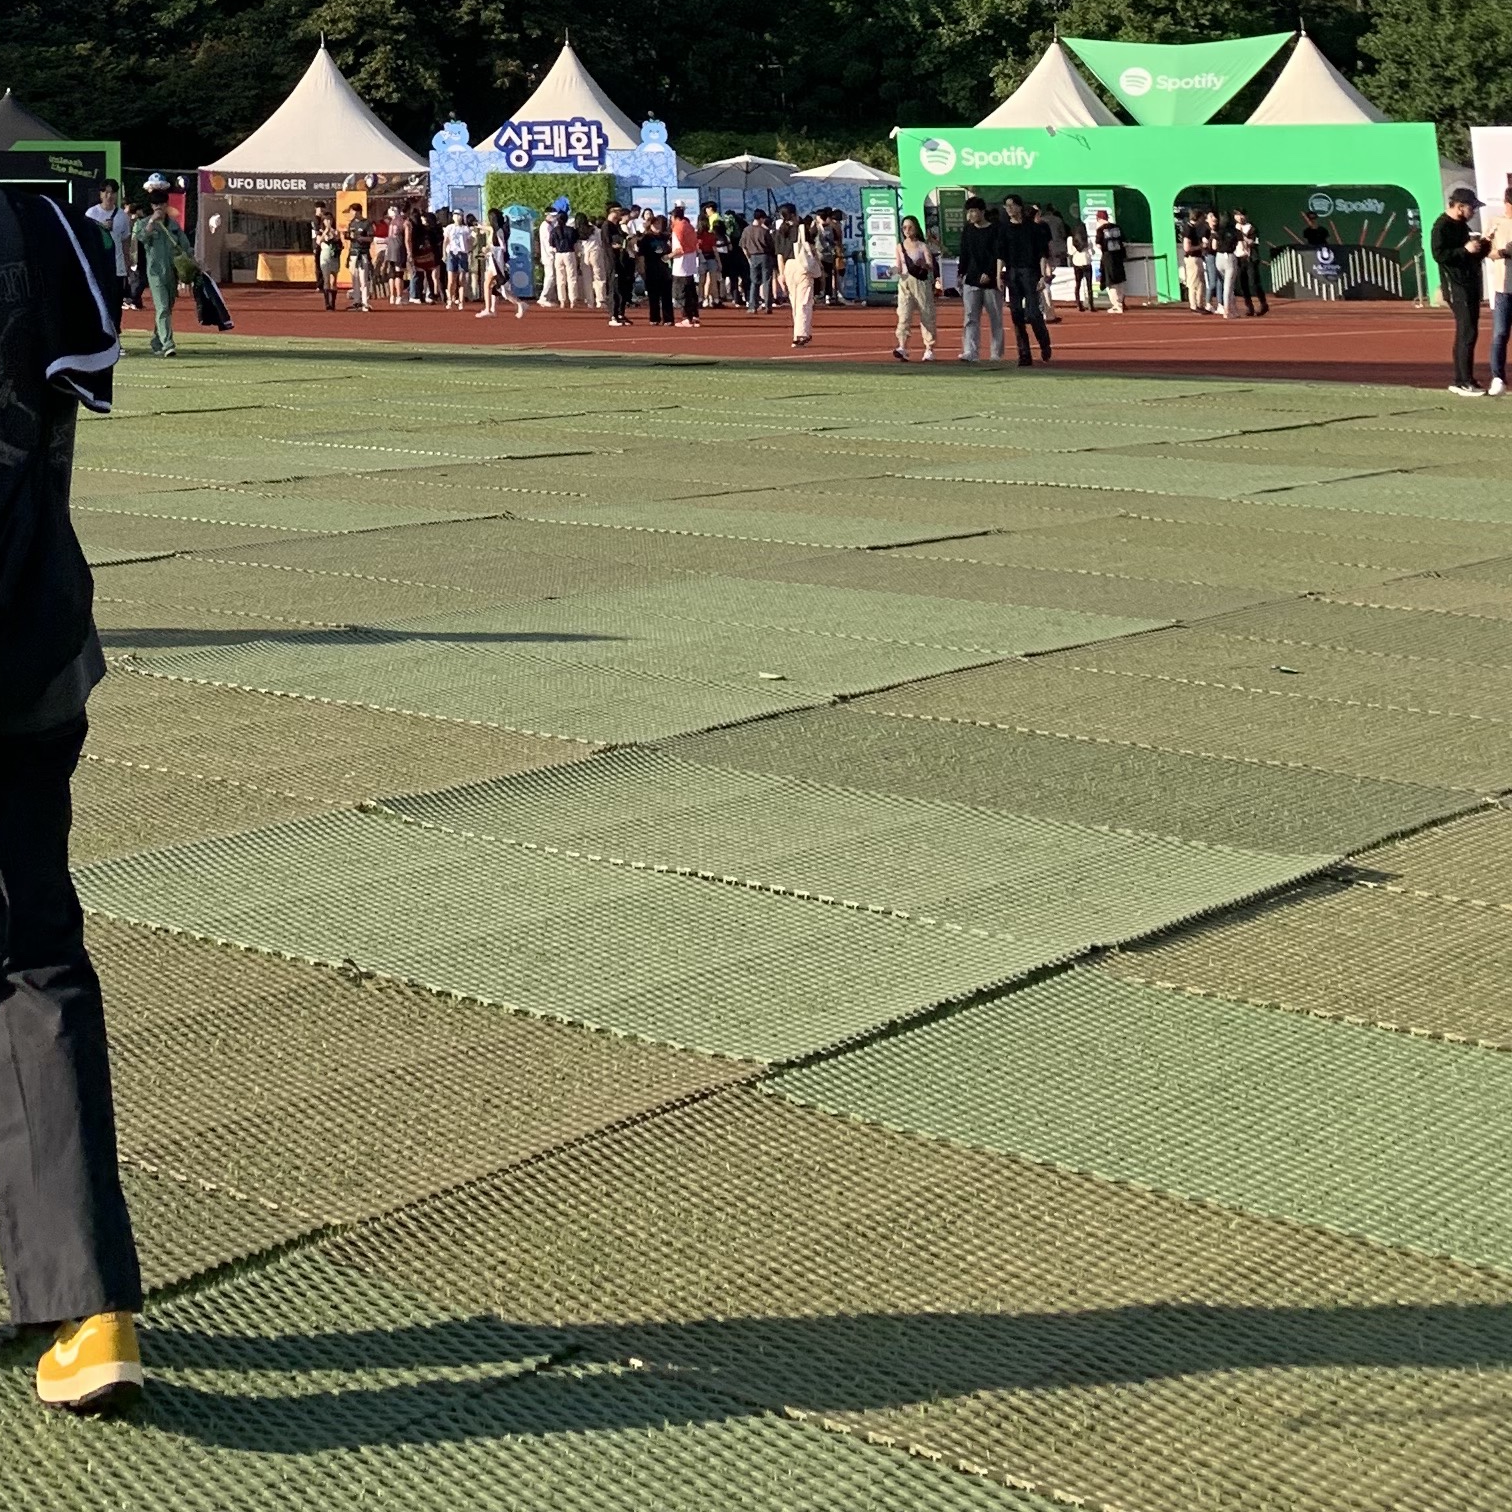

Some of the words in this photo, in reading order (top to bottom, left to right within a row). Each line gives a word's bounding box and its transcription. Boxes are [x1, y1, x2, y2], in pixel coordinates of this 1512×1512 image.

[1156, 73, 1225, 91] Spotify
[497, 121, 604, 168] 상쾌환
[961, 146, 1036, 169] Spotify
[227, 177, 254, 190] UFO
[256, 178, 307, 191] BURGER
[1335, 198, 1385, 214] Spotify
